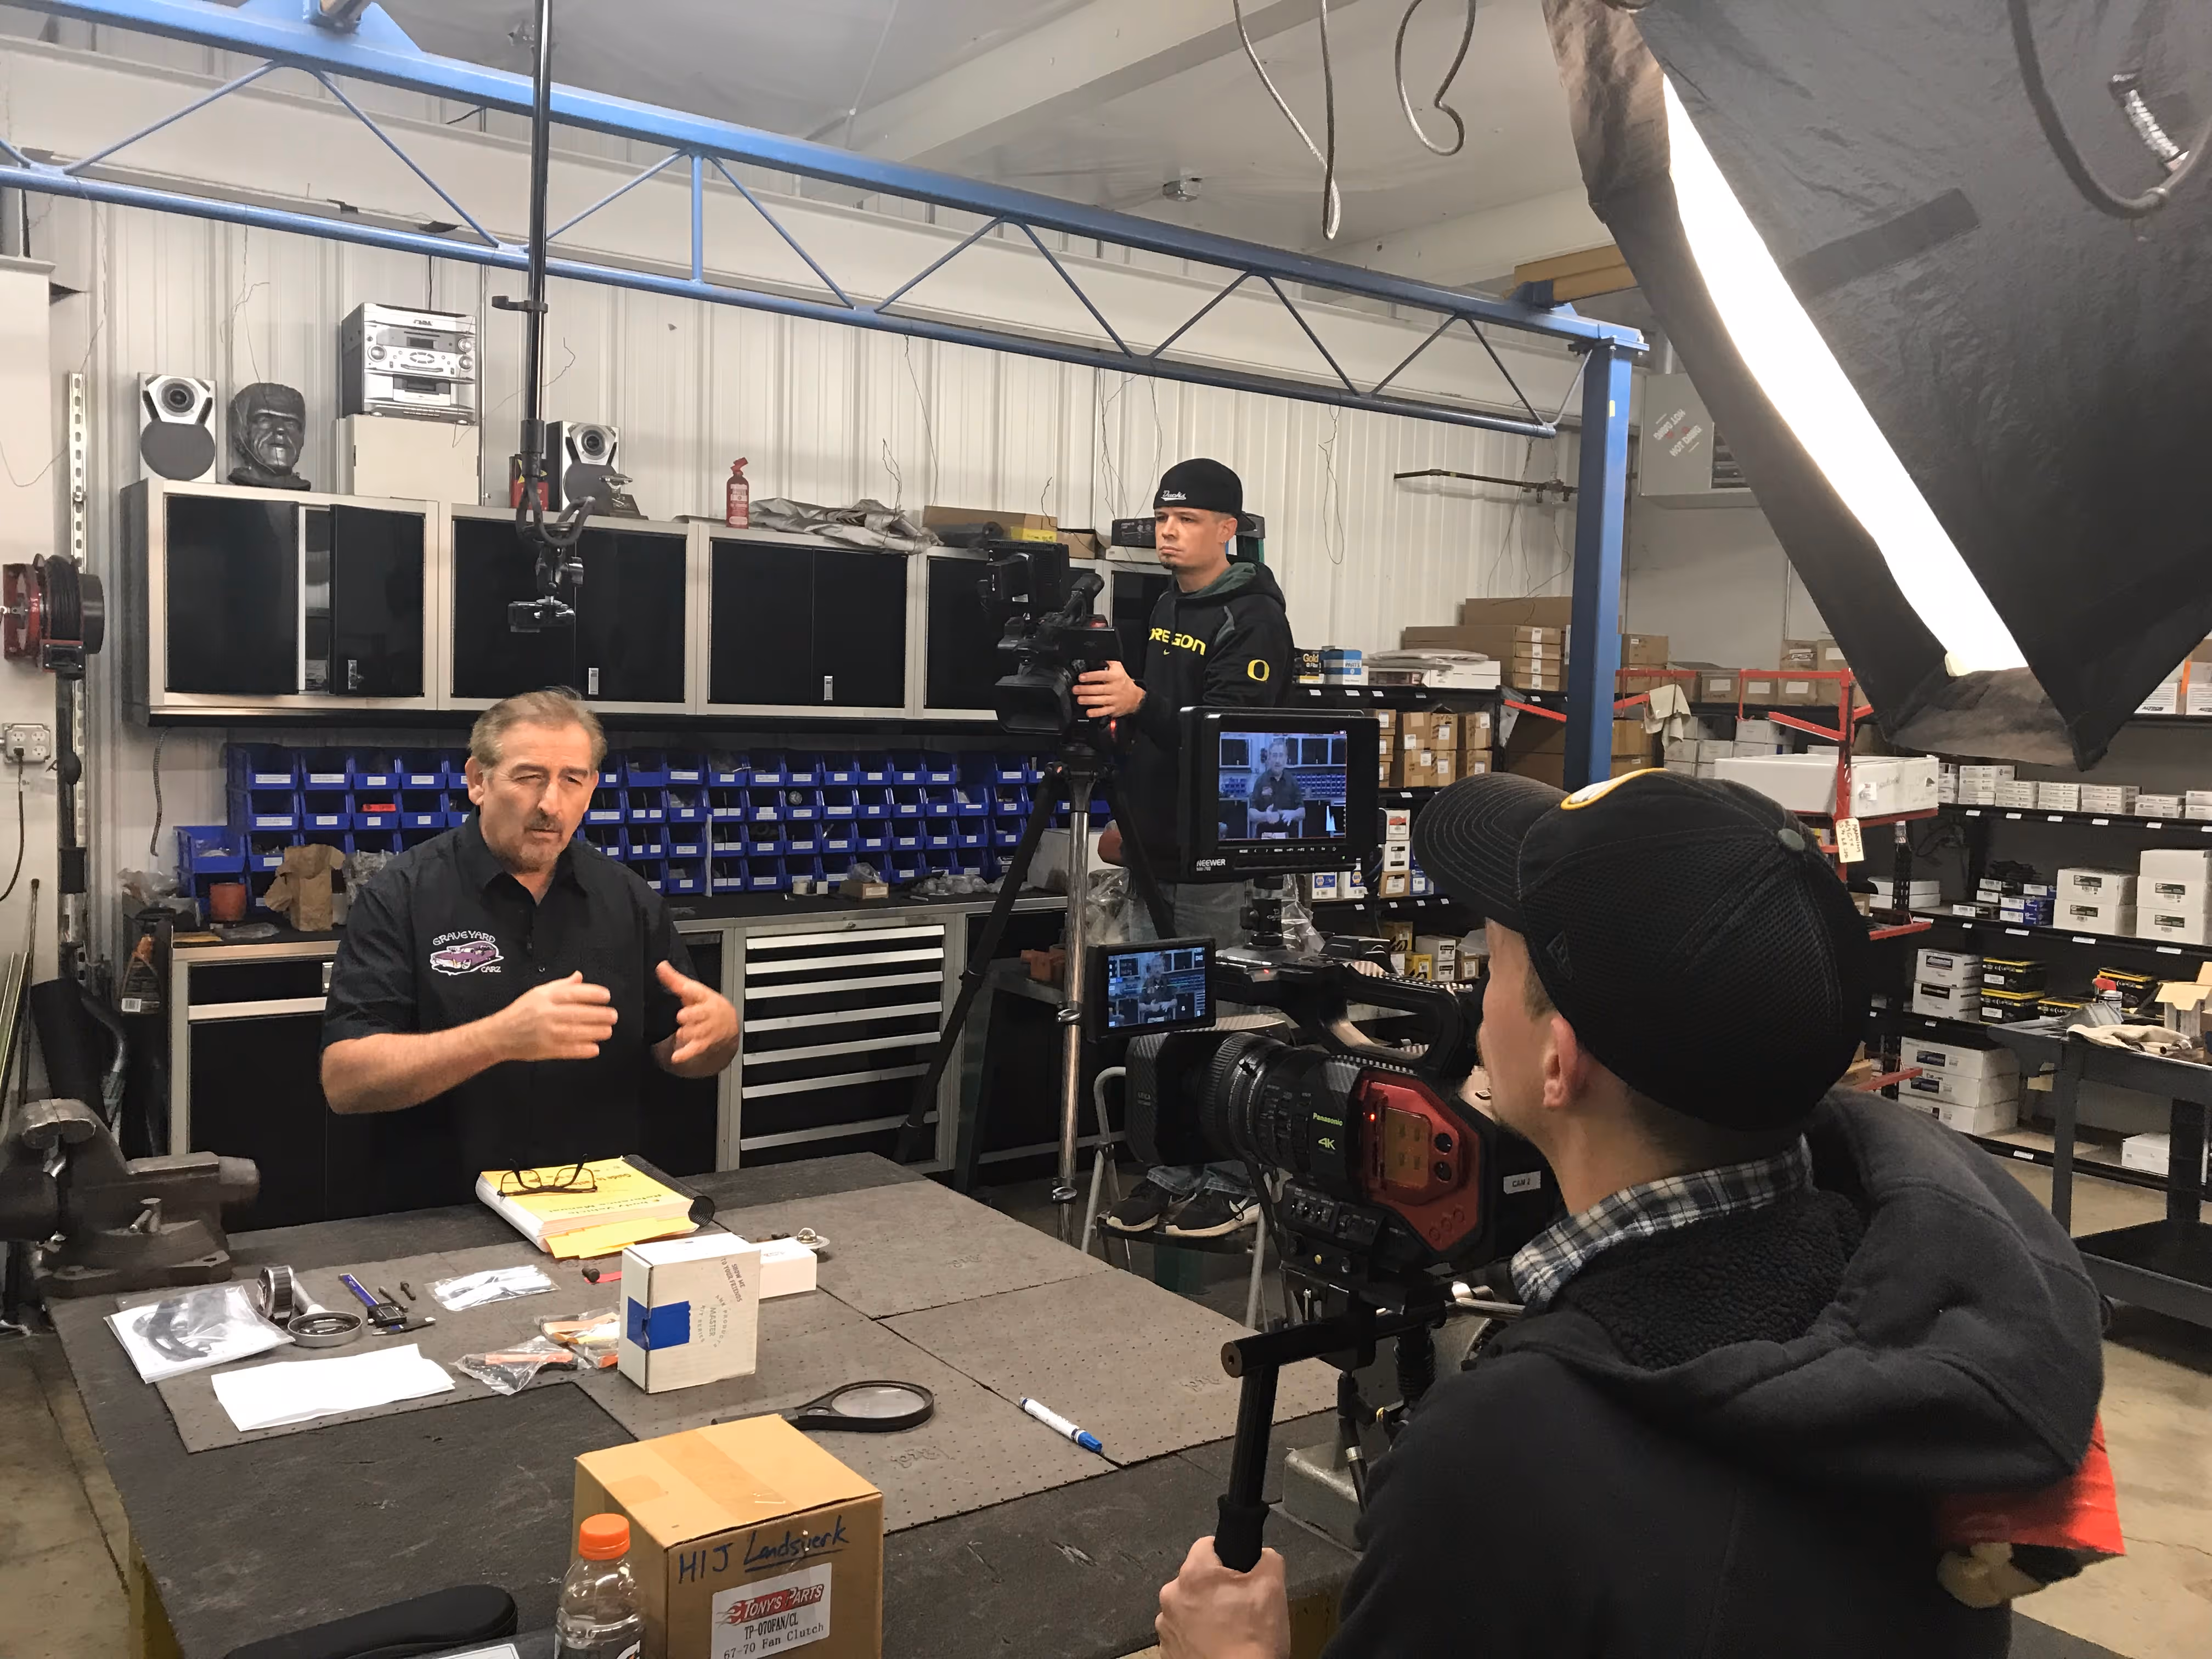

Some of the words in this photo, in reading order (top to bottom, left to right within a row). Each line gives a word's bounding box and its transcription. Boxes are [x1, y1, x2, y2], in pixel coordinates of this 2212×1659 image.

[1162, 490, 1186, 499] Ducks
[1149, 628, 1206, 656] REGON
[1303, 653, 1319, 663] Gold
[1247, 659, 1270, 681] O
[1197, 859, 1226, 867] NEEWER
[432, 930, 496, 946] GRAVEYARD
[1313, 1112, 1343, 1126] Panasonic
[1318, 1137, 1336, 1150] 4K
[723, 1265, 733, 1281] YOUR
[729, 1279, 742, 1303] FRIENDS
[731, 1263, 741, 1279] SHOW
[738, 1279, 746, 1288] ME
[713, 1310, 727, 1348] PRODUCTS
[743, 1596, 783, 1619] TONY'S
[788, 1584, 824, 1605] PARTS
[724, 1643, 756, 1659] 67-70
[762, 1637, 781, 1649] Fan
[787, 1622, 824, 1641] Clutch
